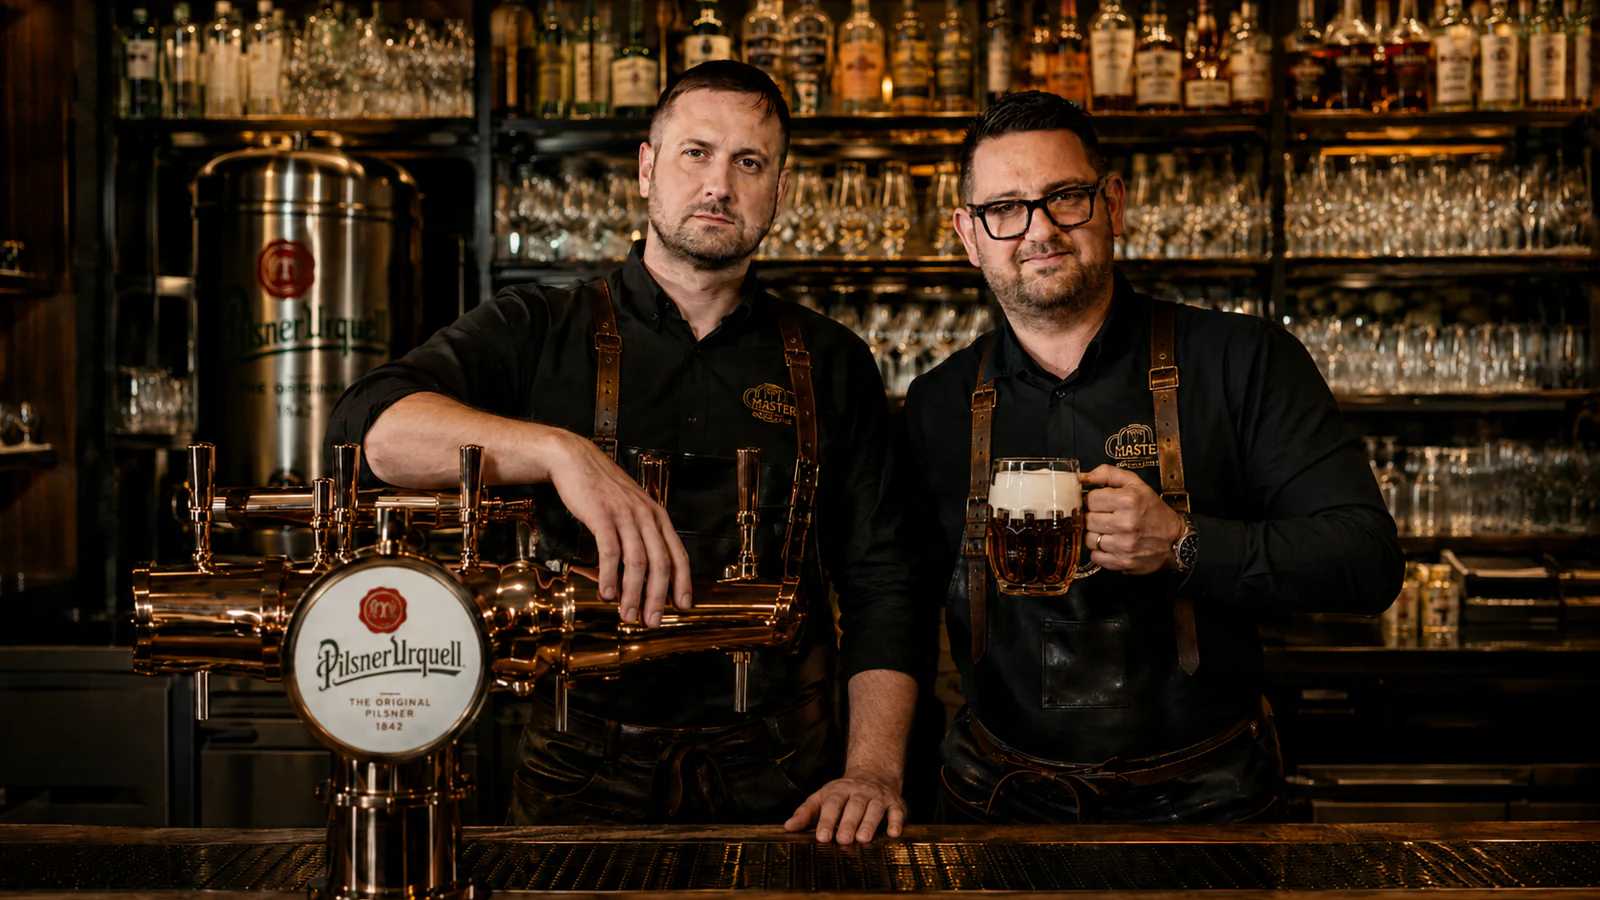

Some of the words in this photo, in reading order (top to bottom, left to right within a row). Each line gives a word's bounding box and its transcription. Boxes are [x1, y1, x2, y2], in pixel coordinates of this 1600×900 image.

[303, 302, 388, 358] Urquell
[752, 397, 797, 417] MASTER
[1115, 444, 1158, 457] MASTE
[316, 639, 392, 692] Pilsner
[390, 636, 462, 678] Urquell
[350, 698, 370, 706] THE
[375, 698, 431, 707] ORIGINAL
[365, 709, 414, 718] PILSNER
[375, 722, 403, 731] 1842
